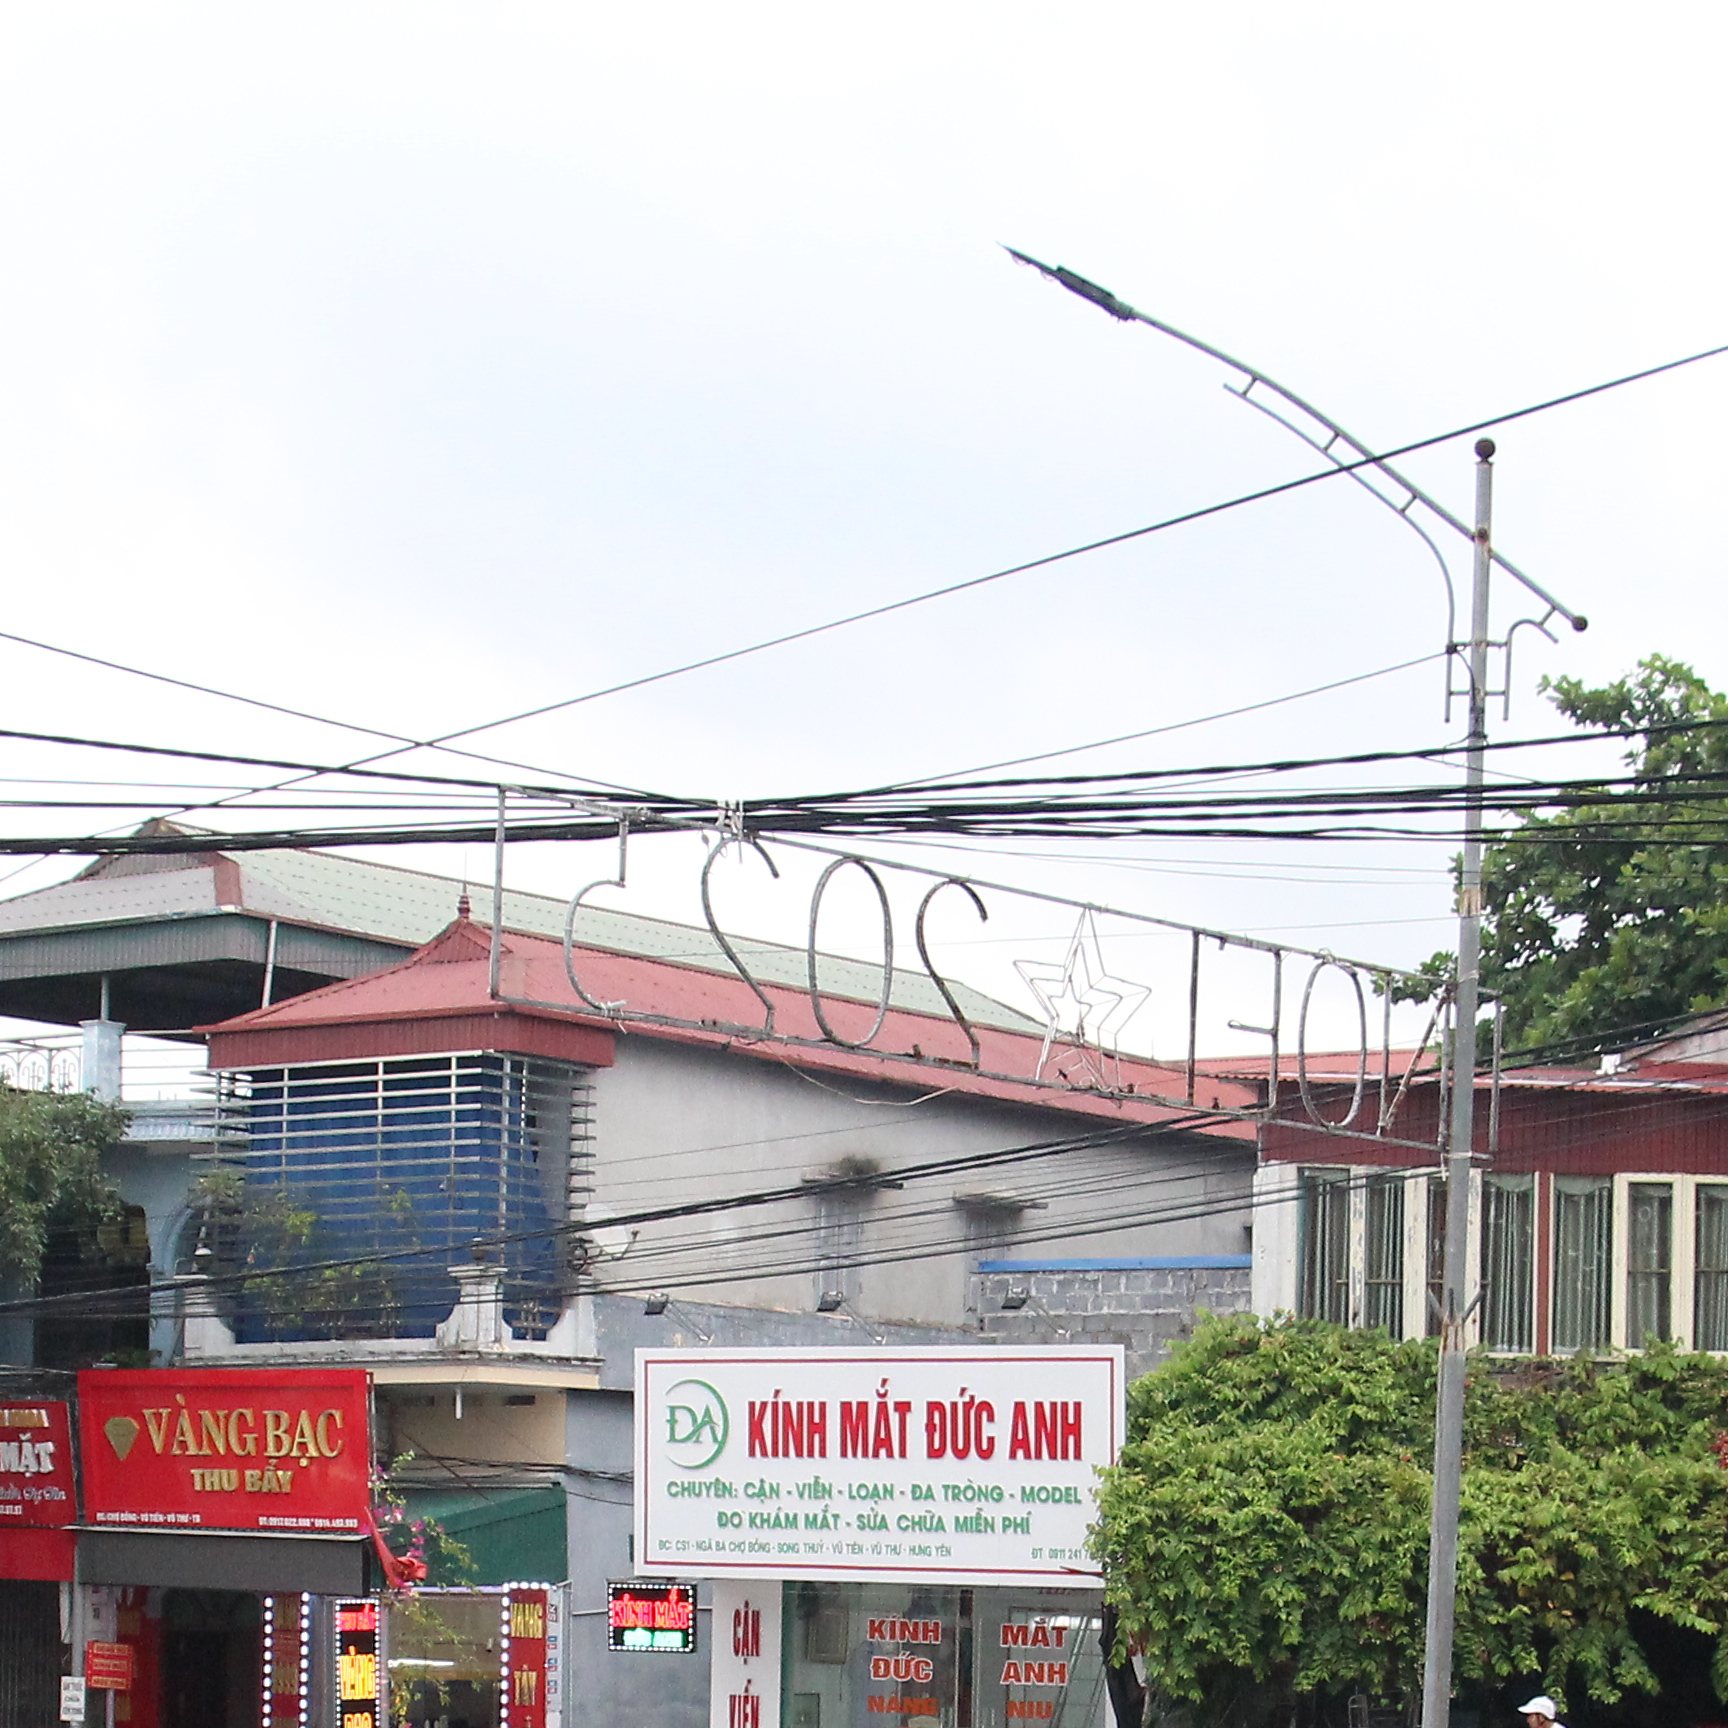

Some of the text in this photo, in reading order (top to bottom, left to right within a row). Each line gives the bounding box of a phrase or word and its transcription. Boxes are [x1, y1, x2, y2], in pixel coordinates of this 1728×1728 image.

[142, 1394, 344, 1467] VÀNG BẠC
[748, 1378, 1083, 1461] KÍNH MẮT ĐỨC ANH
[0, 1433, 55, 1478] MẶT
[191, 1469, 240, 1491] THU
[666, 1477, 738, 1499] CHUYÊN:
[743, 1478, 780, 1504] CẬN
[848, 1482, 894, 1505] LOẠN
[910, 1483, 936, 1502] ĐA
[941, 1478, 1004, 1503] TRÒNG
[1021, 1485, 1083, 1504] MODEL
[717, 1511, 743, 1529] ĐO
[748, 1505, 798, 1530] KHÁM
[803, 1503, 840, 1531] MẮT
[856, 1507, 890, 1532] SỬA
[896, 1509, 947, 1533] CHỮA
[954, 1506, 996, 1533] MIỄN
[1001, 1510, 1032, 1534] PHÍ
[715, 1540, 726, 1551] BA
[728, 1540, 746, 1555] CHỢ
[777, 1541, 800, 1555] SONG
[733, 1600, 761, 1665] CẬN
[868, 1616, 1068, 1648] KÍNH MẮT
[871, 1651, 1069, 1685] ĐỨC ANH
[1007, 1701, 1053, 1719] NIU
